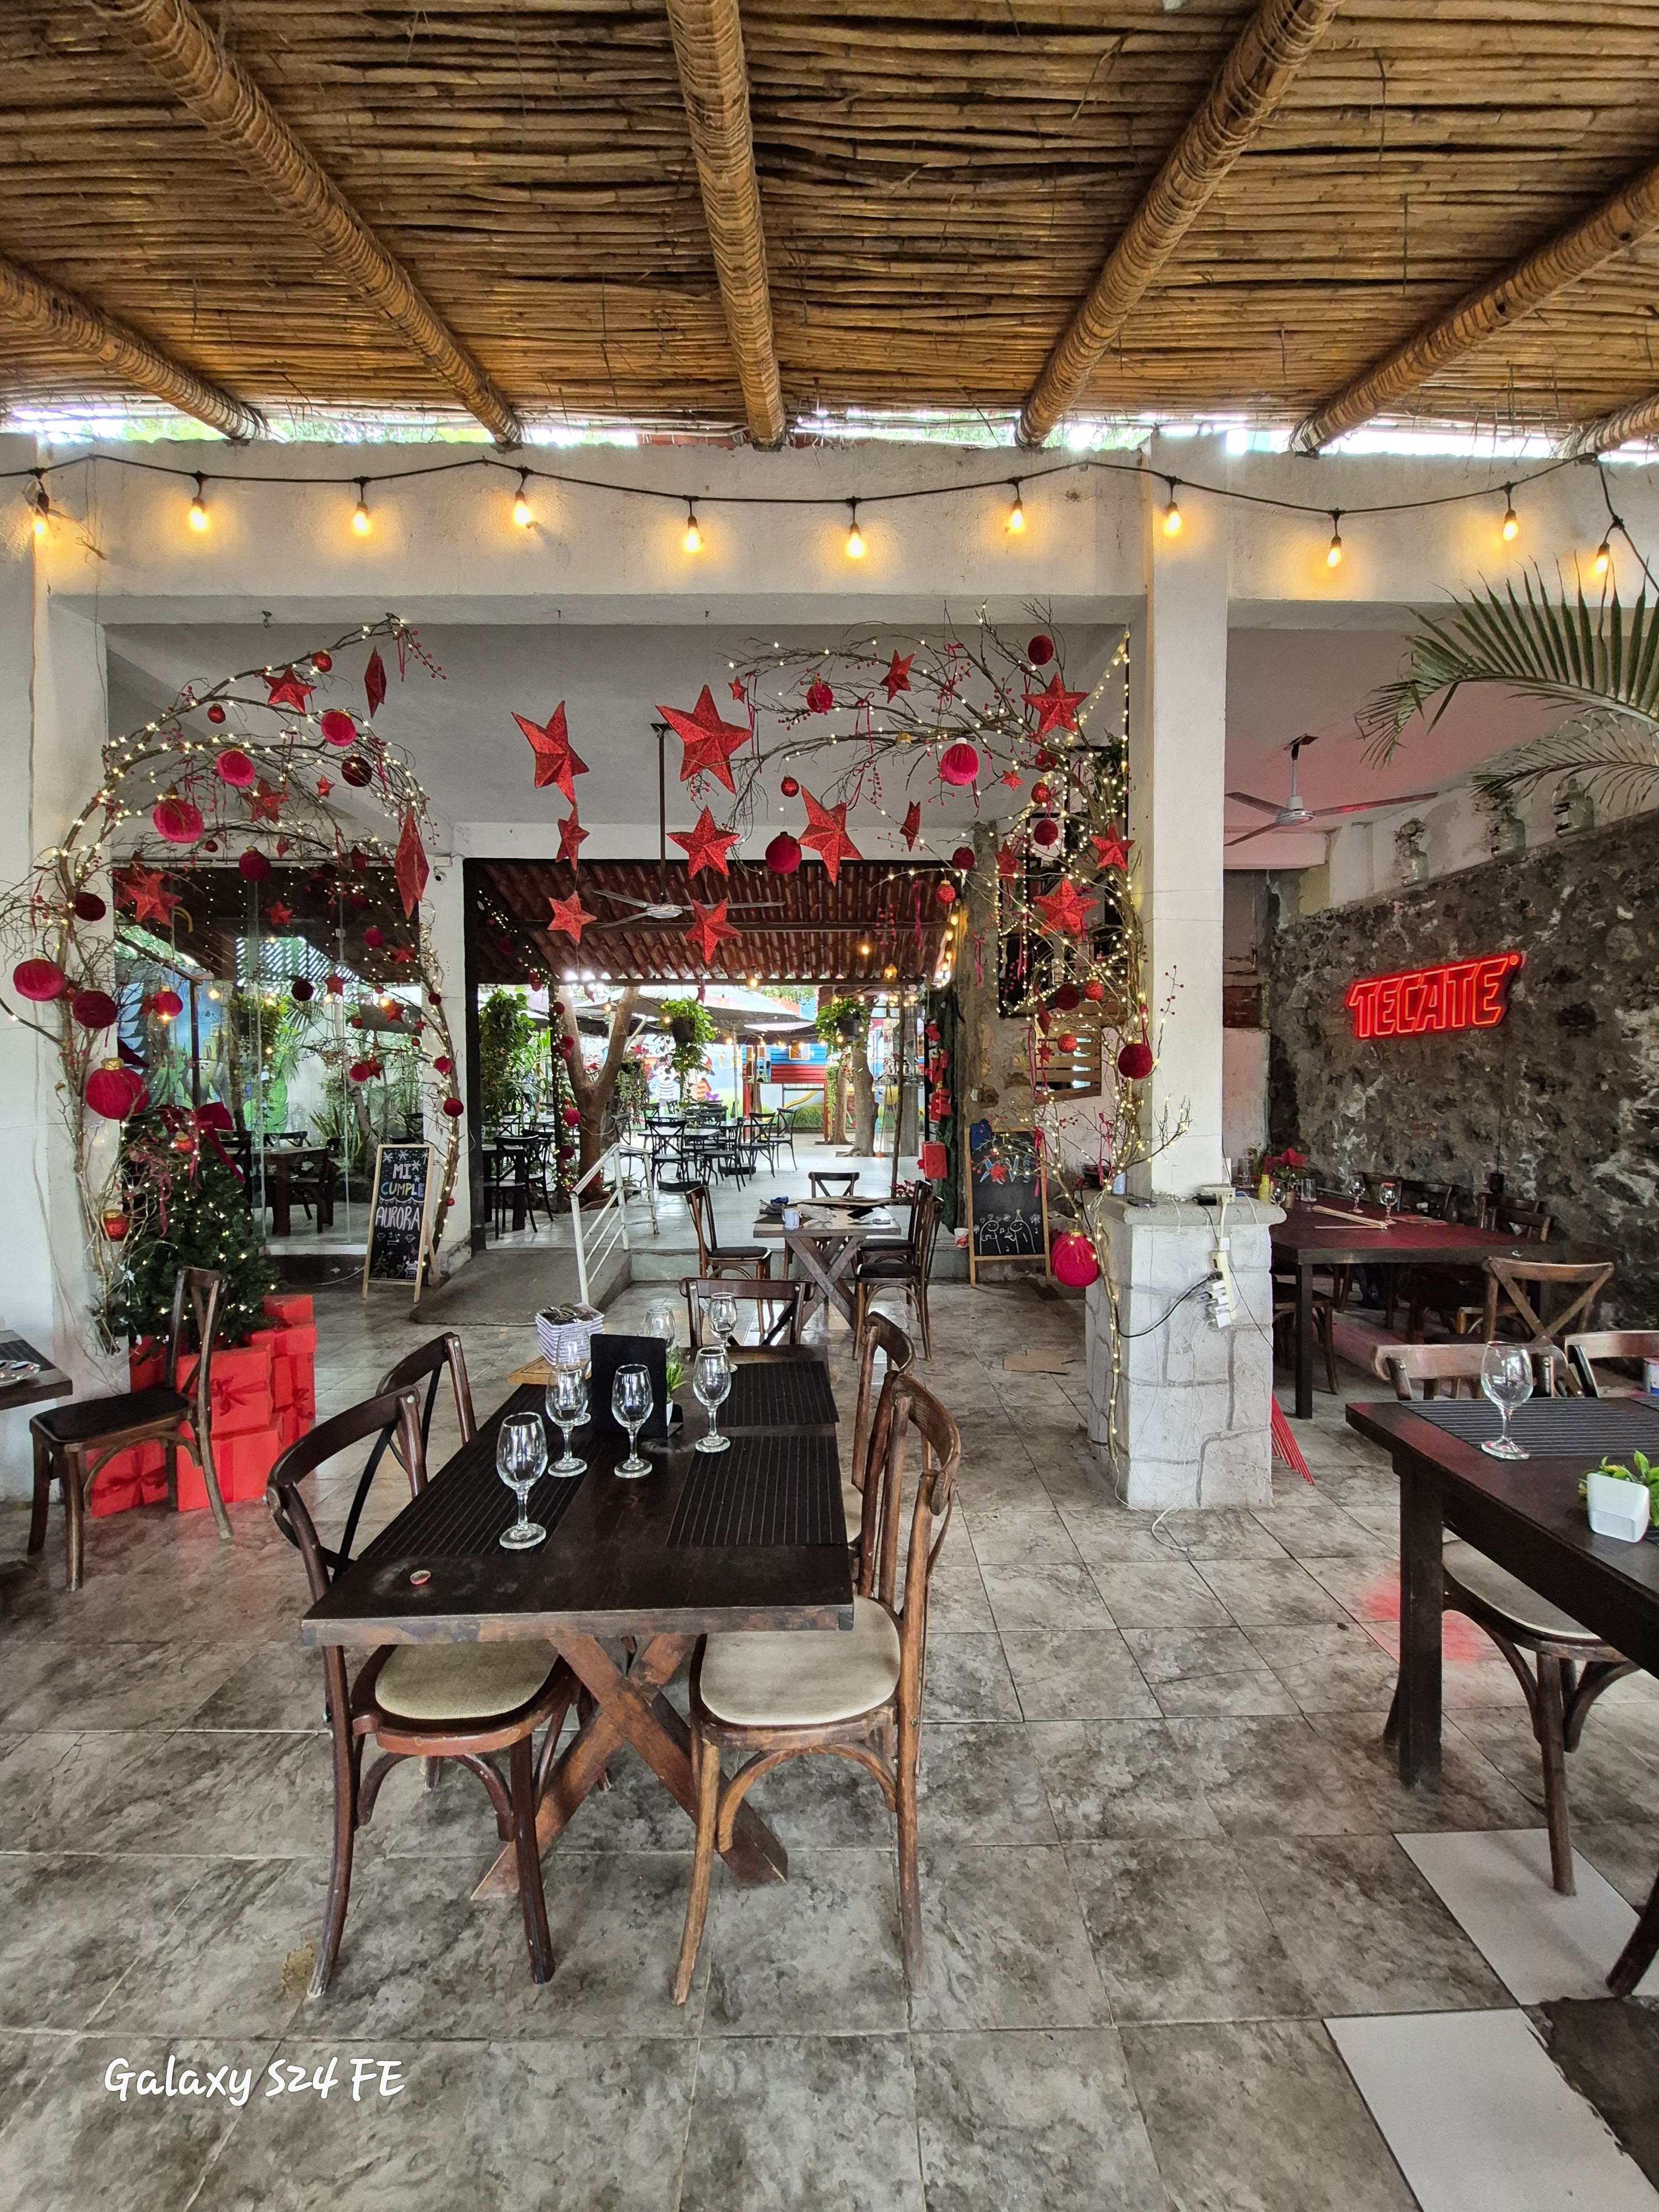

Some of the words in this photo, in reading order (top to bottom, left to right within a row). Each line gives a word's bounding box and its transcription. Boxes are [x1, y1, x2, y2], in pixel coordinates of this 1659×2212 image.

[1349, 957, 1509, 1038] TECATE
[392, 1163, 412, 1180] MI
[380, 1181, 425, 1197] CUMPLE
[375, 1206, 421, 1232] AURORA
